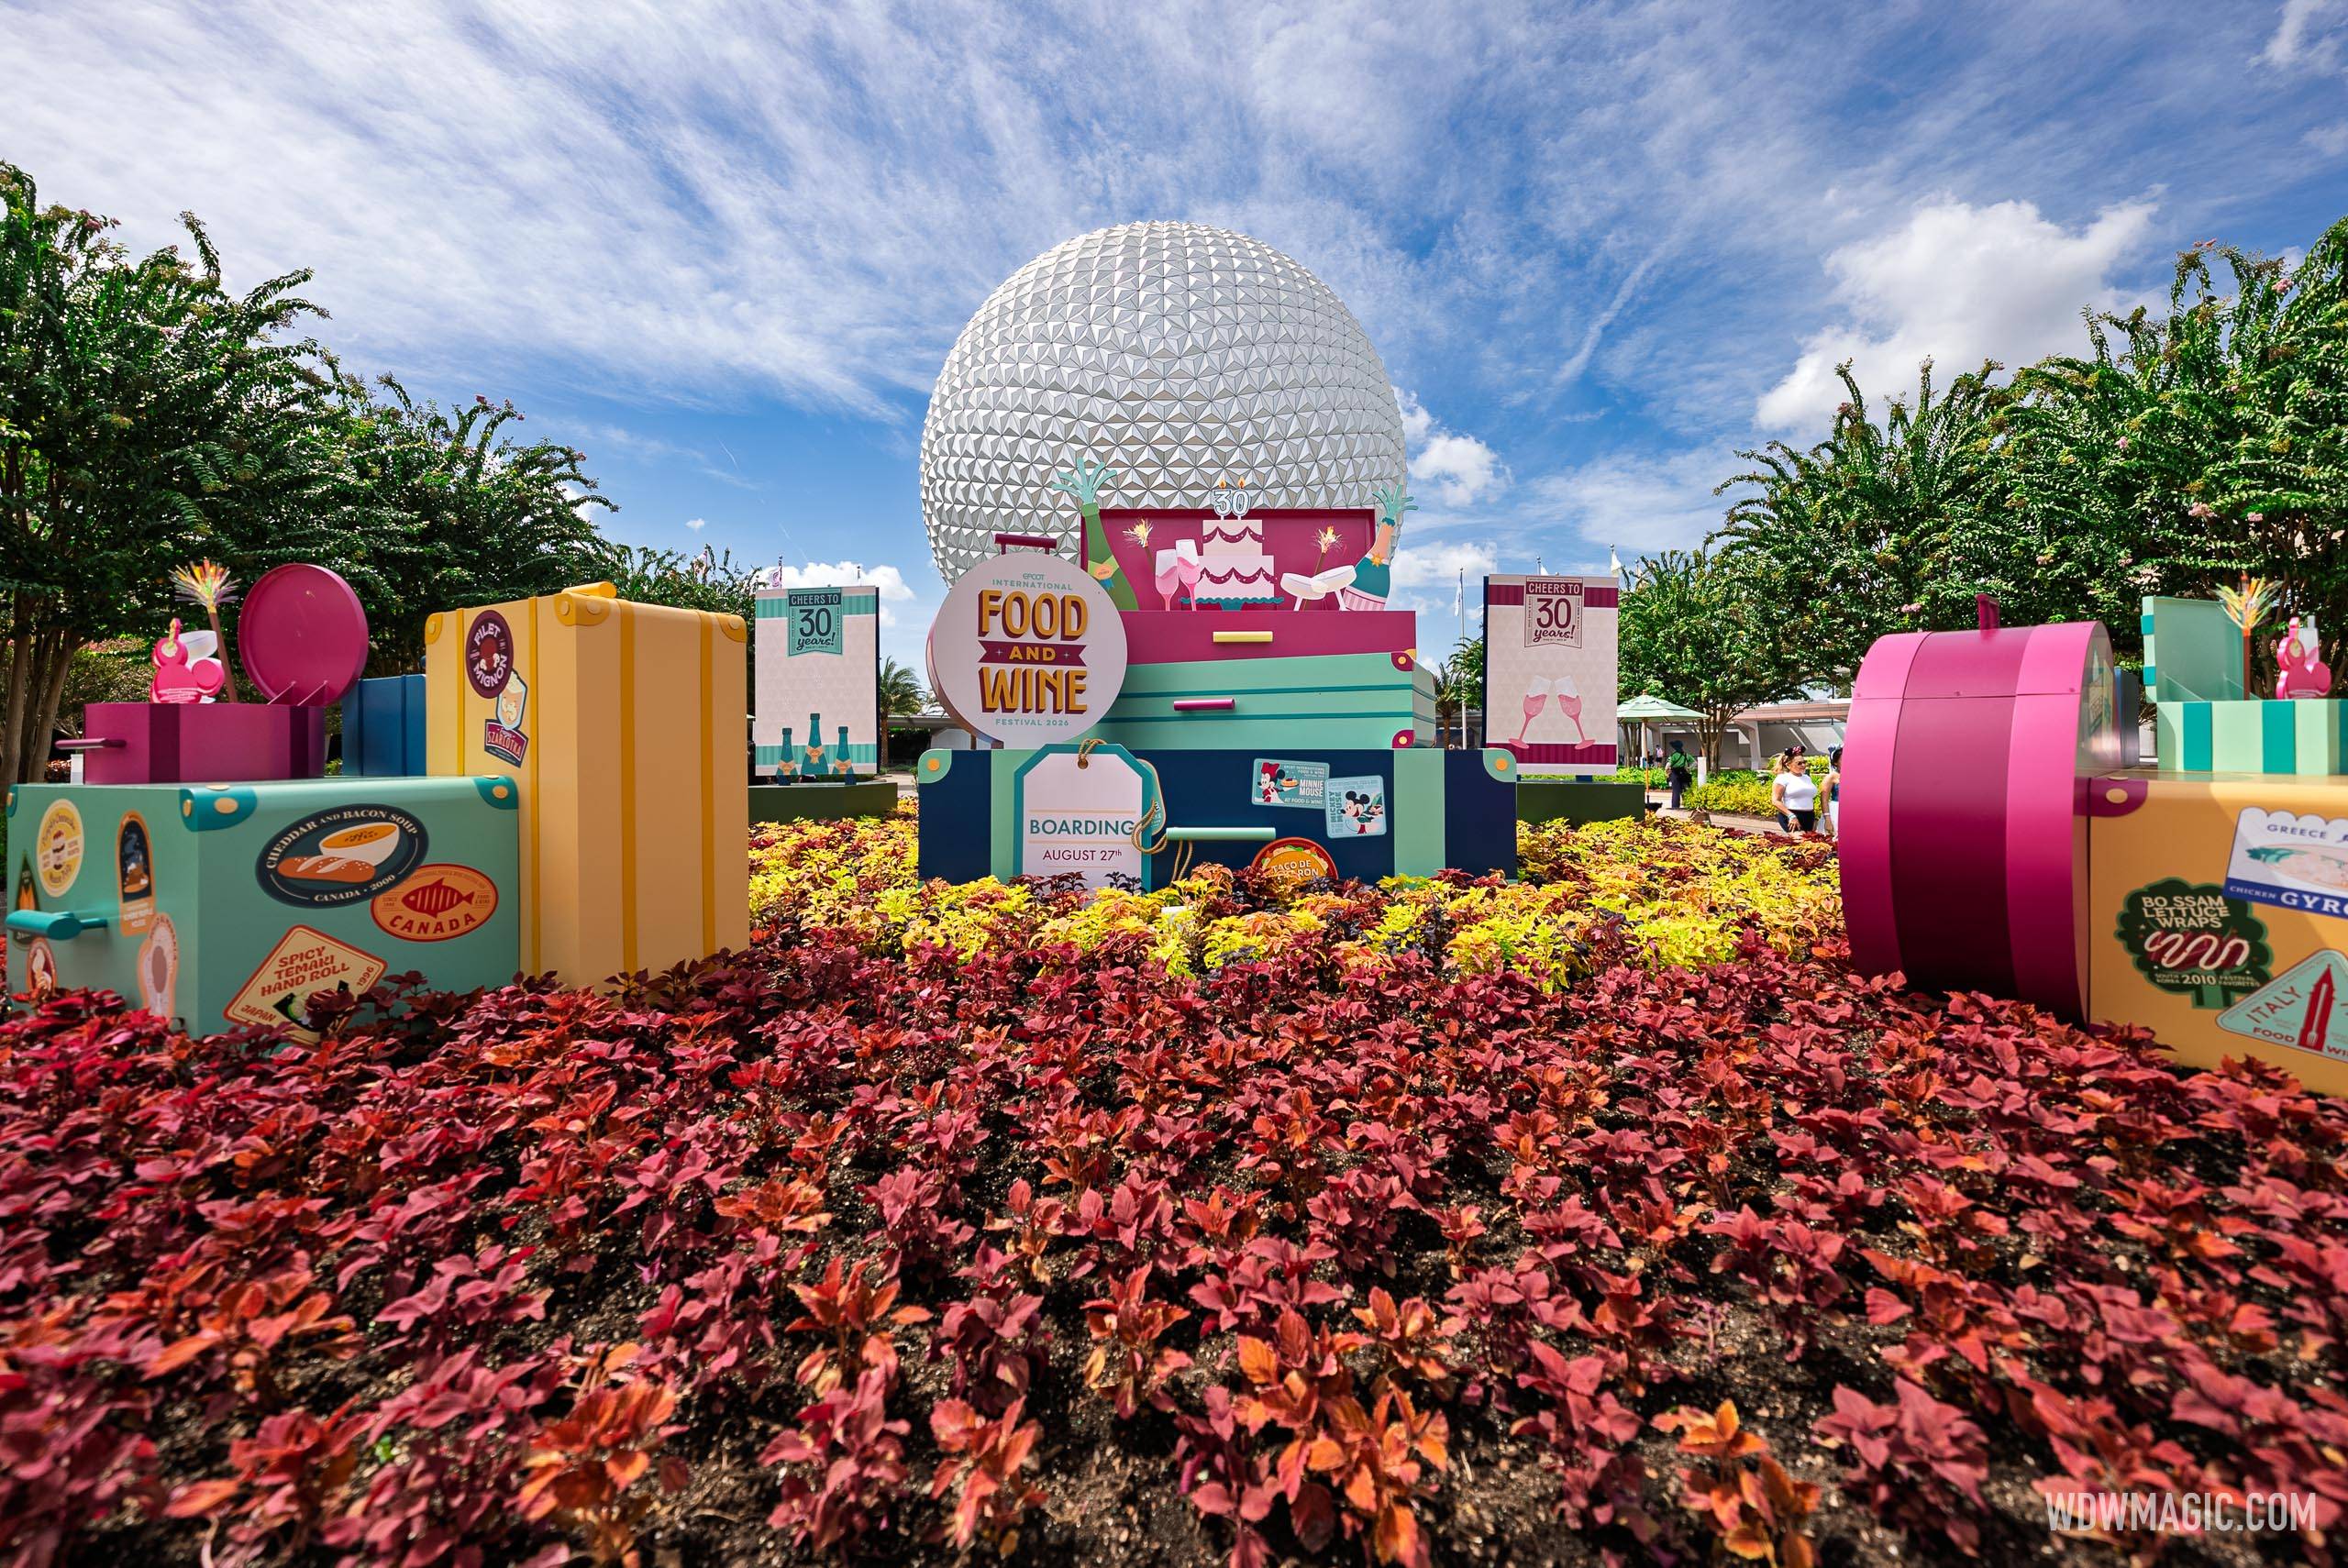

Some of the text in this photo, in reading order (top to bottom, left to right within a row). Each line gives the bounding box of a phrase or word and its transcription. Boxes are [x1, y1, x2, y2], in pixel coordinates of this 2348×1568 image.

[1213, 489, 1250, 516] 30
[992, 580, 1072, 591] INTERNATIONAL
[1528, 583, 1580, 594] CHEERS TO
[791, 594, 839, 605] CHEERS TO
[799, 608, 832, 636] 30
[978, 590, 1089, 641] FOOD
[1536, 598, 1572, 629] 30
[473, 623, 501, 646] FILET
[796, 632, 836, 650] years!
[1533, 624, 1576, 642] years!
[1009, 646, 1057, 661] AND
[472, 654, 508, 688] MIGNON
[978, 667, 1087, 714] WINE
[995, 718, 1043, 726] FESTIVAL
[1299, 787, 1324, 797] MOUSE
[1300, 778, 1324, 789] MINNIE
[1328, 791, 1337, 823] MICKEY
[1029, 819, 1136, 835] BOARDING
[2266, 823, 2328, 840] GREECE
[266, 809, 418, 869] CHEDDAR AND BACON SOUP
[1042, 849, 1123, 861] AUGUST 27th
[1273, 861, 1298, 873] TACO
[1299, 860, 1312, 868] DE
[314, 889, 360, 902] CANADA
[369, 874, 396, 891] 2000
[2230, 886, 2277, 900] CHICKEN
[2142, 896, 2225, 908] BO SSAM
[2143, 907, 2231, 918] LETTUCE
[389, 912, 477, 934] CANADA
[2155, 917, 2223, 928] WRAPS
[278, 946, 327, 967] SPICY
[274, 955, 335, 981] TEMAKI
[357, 966, 374, 987] 1996
[260, 963, 350, 997] HAND ROLL
[2181, 974, 2217, 986] 2010
[240, 1004, 277, 1022] JAPAN
[2245, 985, 2303, 1023] ITALY
[2252, 1026, 2296, 1043] FOOD
[2326, 1044, 2348, 1057] WI
